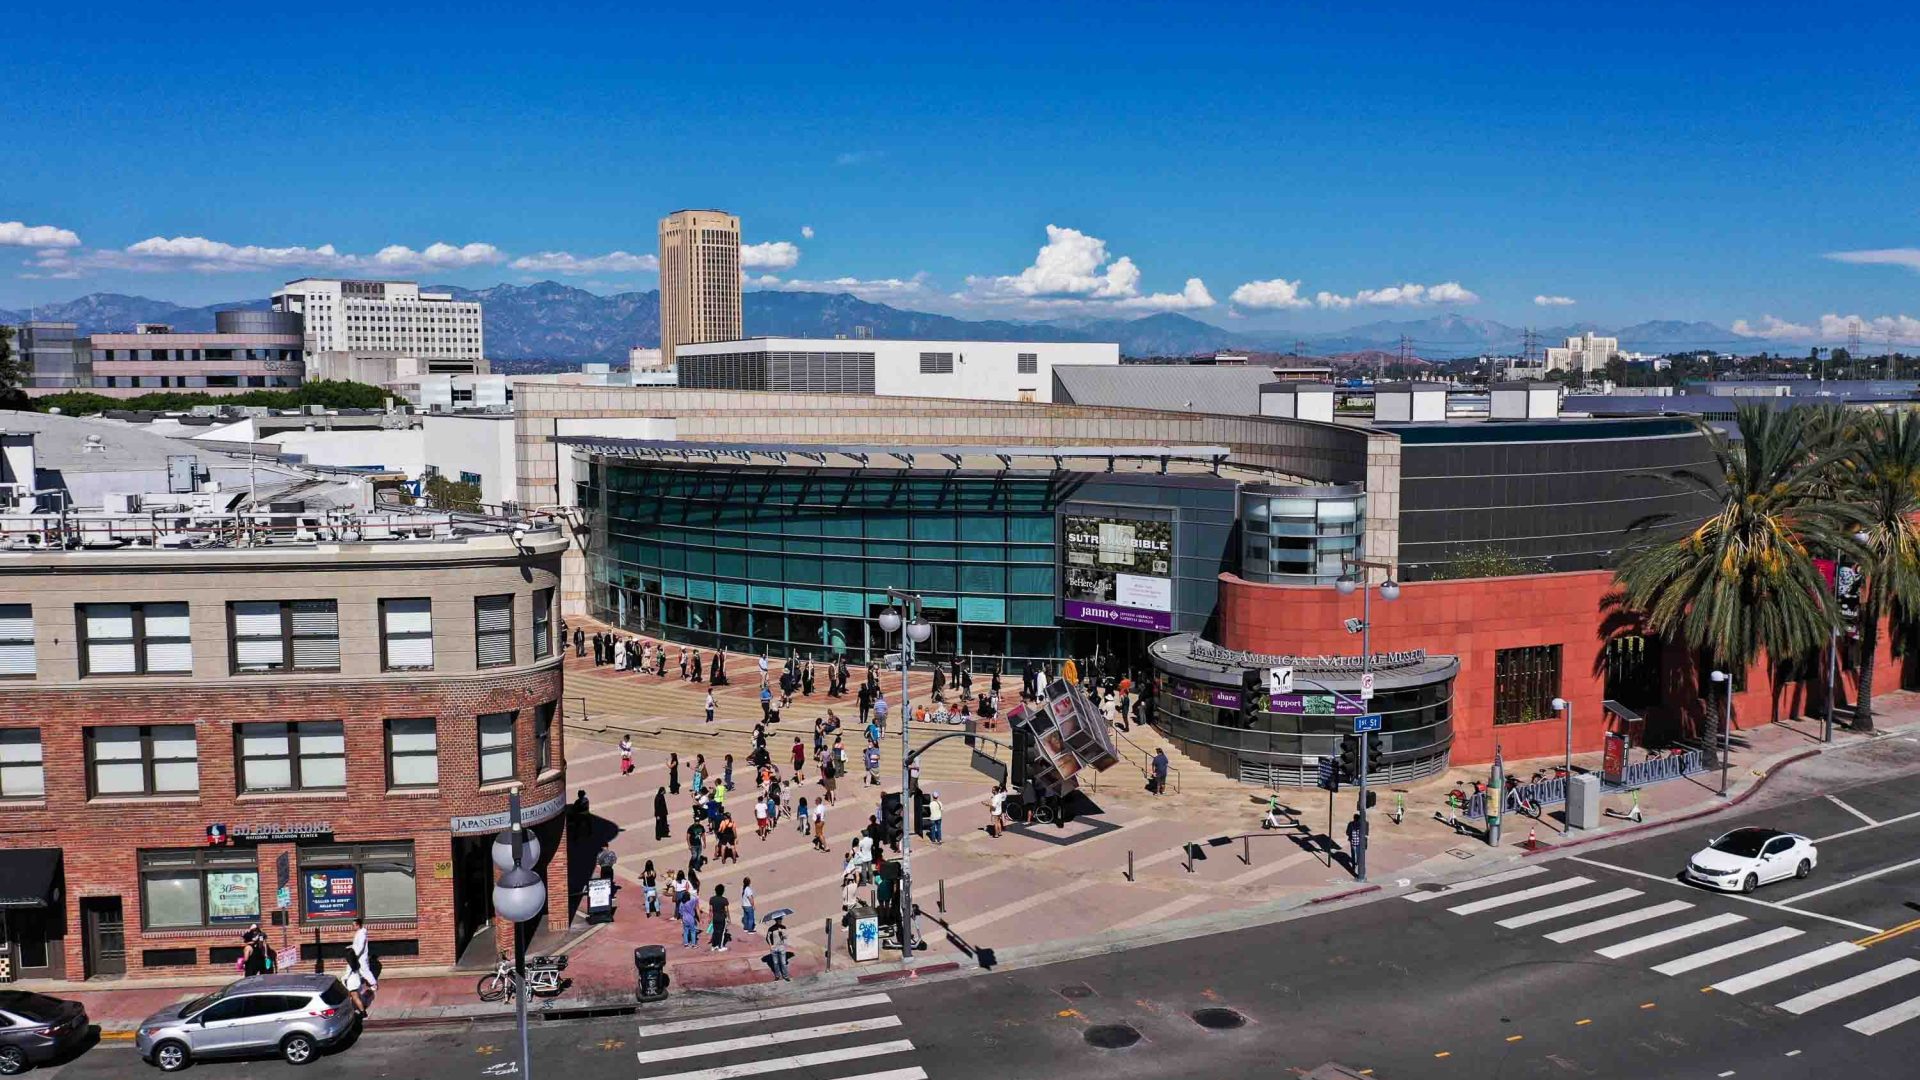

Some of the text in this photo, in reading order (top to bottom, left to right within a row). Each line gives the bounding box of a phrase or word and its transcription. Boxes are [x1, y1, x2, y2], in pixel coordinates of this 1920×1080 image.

[1068, 533, 1108, 545] SUTRA
[1130, 539, 1168, 551] BIBLE
[1081, 607, 1109, 619] janm
[1240, 649, 1310, 667] AMERICAN
[1387, 648, 1425, 664] MUSEUM
[1217, 692, 1237, 702] share
[1272, 700, 1302, 710] support
[1358, 718, 1377, 728] 1st St
[255, 822, 281, 835] FOR
[286, 820, 330, 834] BROKE
[456, 816, 505, 832] JAPANESE
[435, 862, 452, 871] 369
